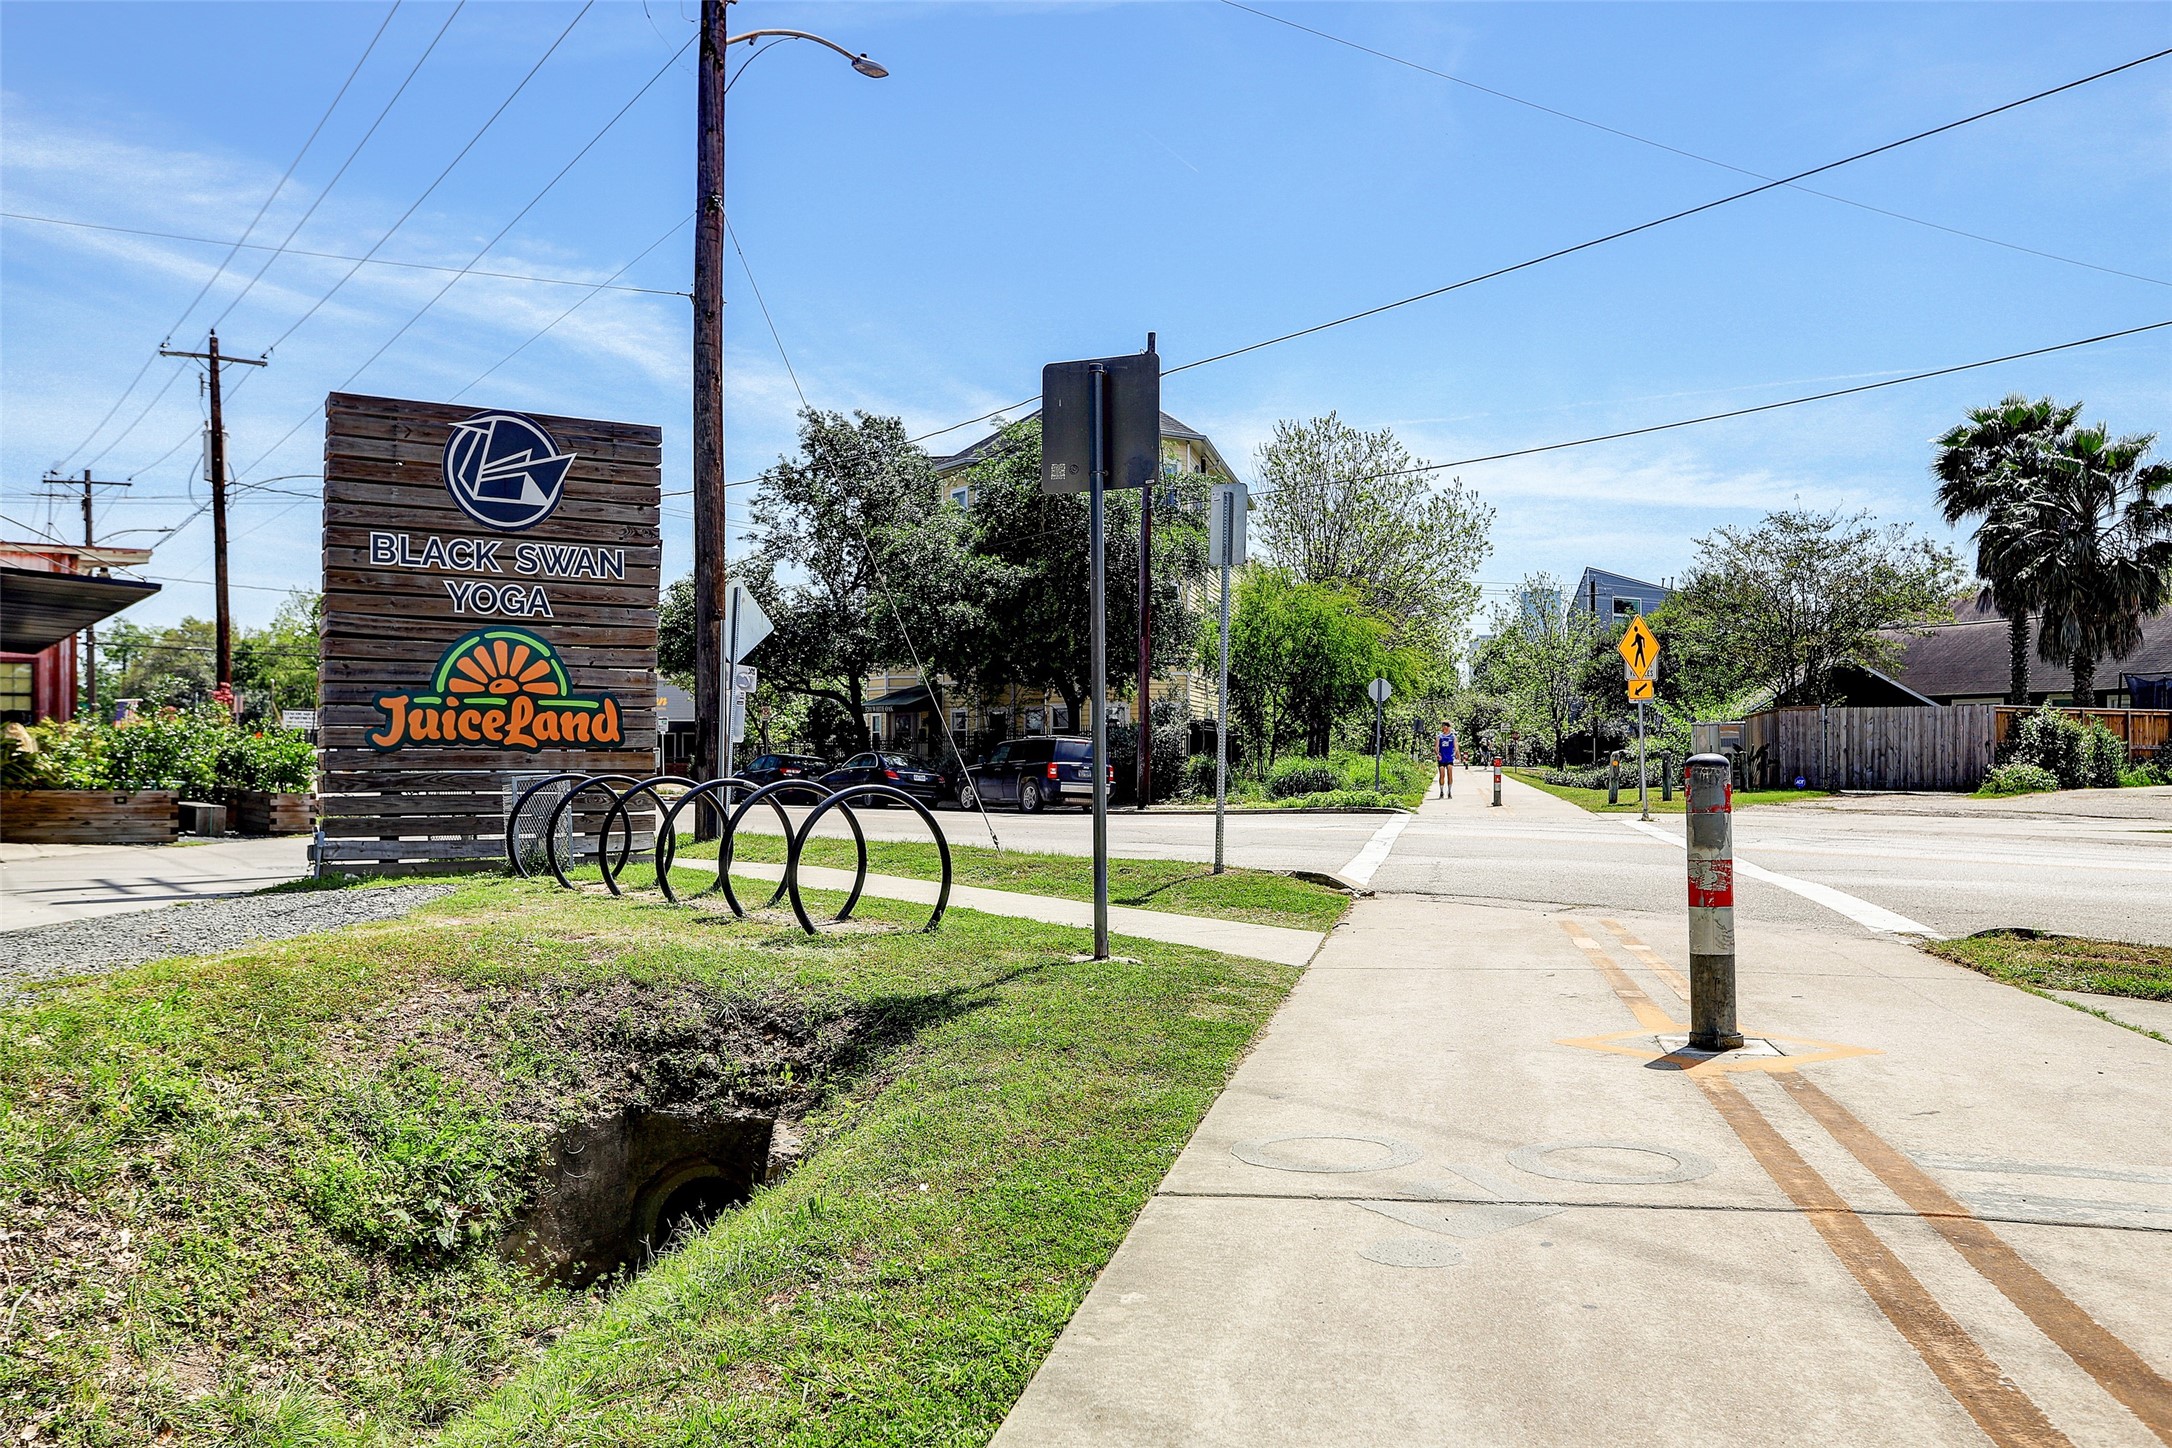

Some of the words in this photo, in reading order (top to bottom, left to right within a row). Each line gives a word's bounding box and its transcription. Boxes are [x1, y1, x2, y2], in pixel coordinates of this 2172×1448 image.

[369, 531, 502, 573] BLACK
[514, 542, 625, 580] SWAN
[443, 580, 553, 618] YOGA
[371, 695, 621, 749] JuiceLand
